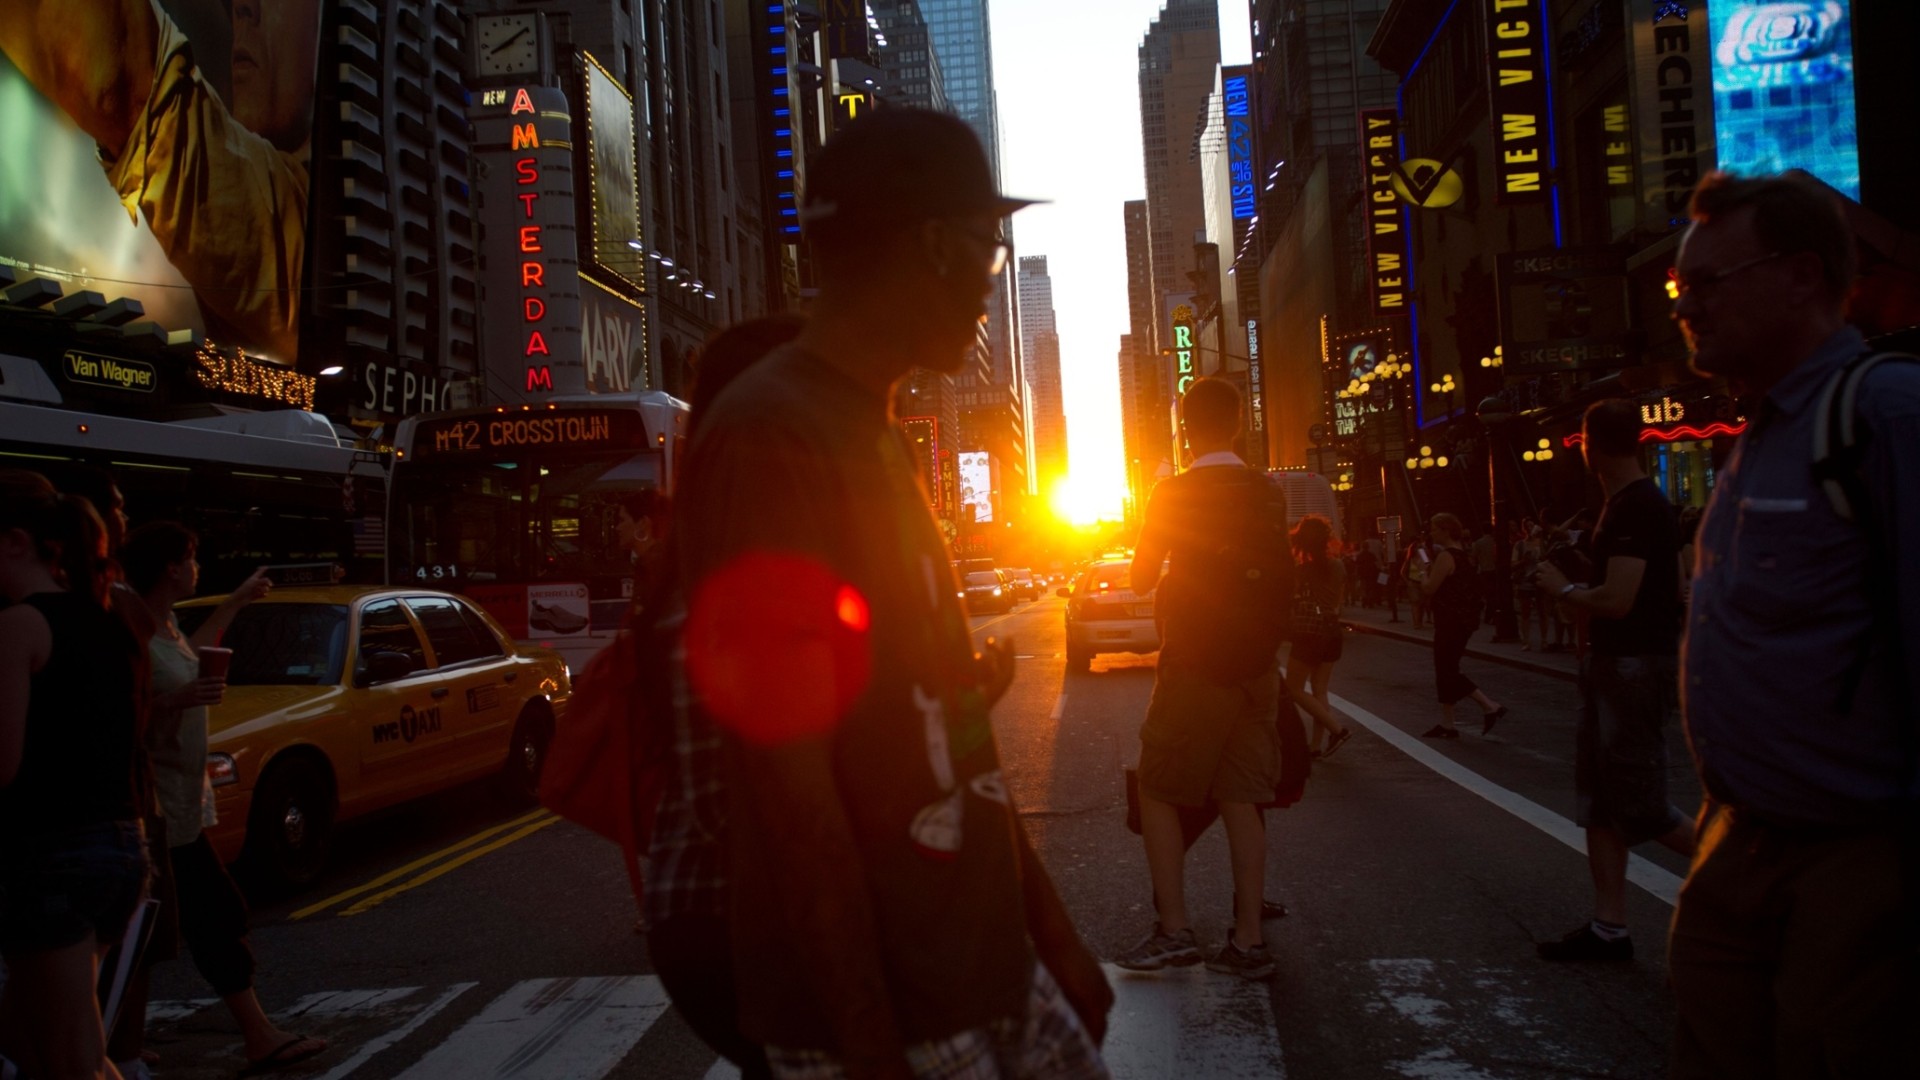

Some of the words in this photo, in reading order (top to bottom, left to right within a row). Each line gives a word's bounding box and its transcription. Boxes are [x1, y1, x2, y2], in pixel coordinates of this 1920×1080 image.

[483, 90, 506, 106] NEW
[1225, 75, 1248, 117] NEW
[1502, 113, 1541, 193] NEW
[1367, 117, 1400, 236] VICTORY
[511, 87, 553, 392] AMSTERDAM
[1376, 252, 1403, 309] NEW
[65, 351, 98, 378] Van
[101, 355, 152, 387] Wagner
[196, 336, 318, 412] Subway
[488, 415, 610, 446] CROSSTOWN
[415, 564, 457, 580] 431
[373, 722, 399, 744] NYC
[400, 704, 441, 743] TAXI
